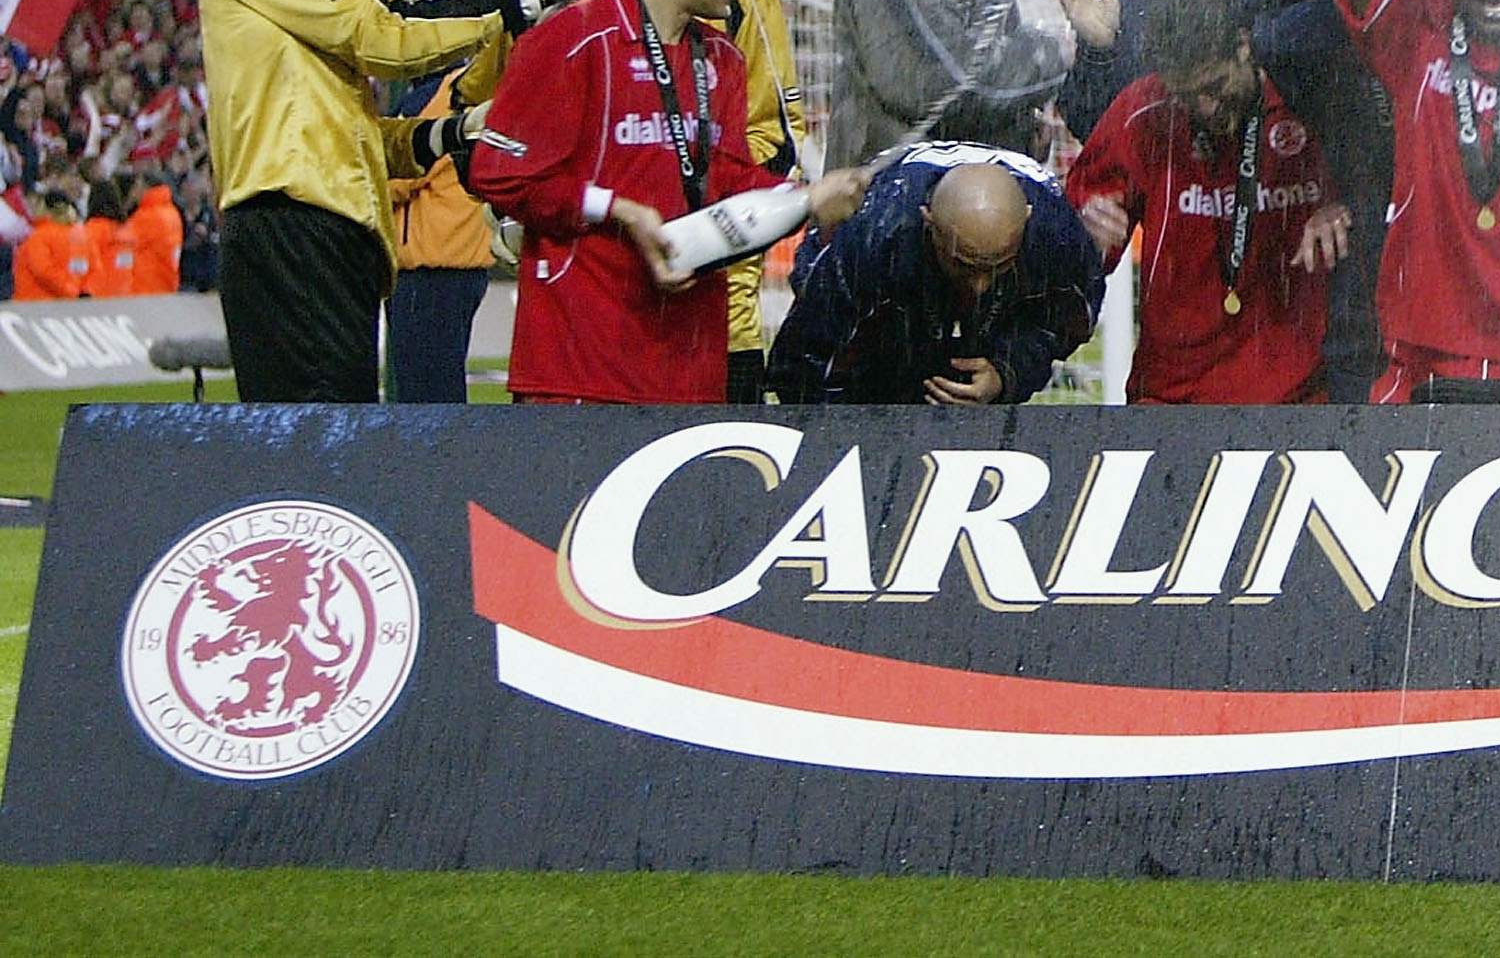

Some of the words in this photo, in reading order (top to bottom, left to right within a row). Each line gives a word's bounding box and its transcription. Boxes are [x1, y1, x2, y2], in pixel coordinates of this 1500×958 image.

[643, 22, 672, 85] CARLING
[1454, 78, 1478, 144] CARLING
[669, 113, 695, 177] CARLING
[1178, 180, 1324, 218] dialahone
[161, 512, 397, 594] MIDDLESBROUGH
[137, 627, 163, 650] 19
[377, 621, 409, 645] 86
[147, 692, 293, 766] FOOTBALL
[298, 695, 374, 757] CLUB
